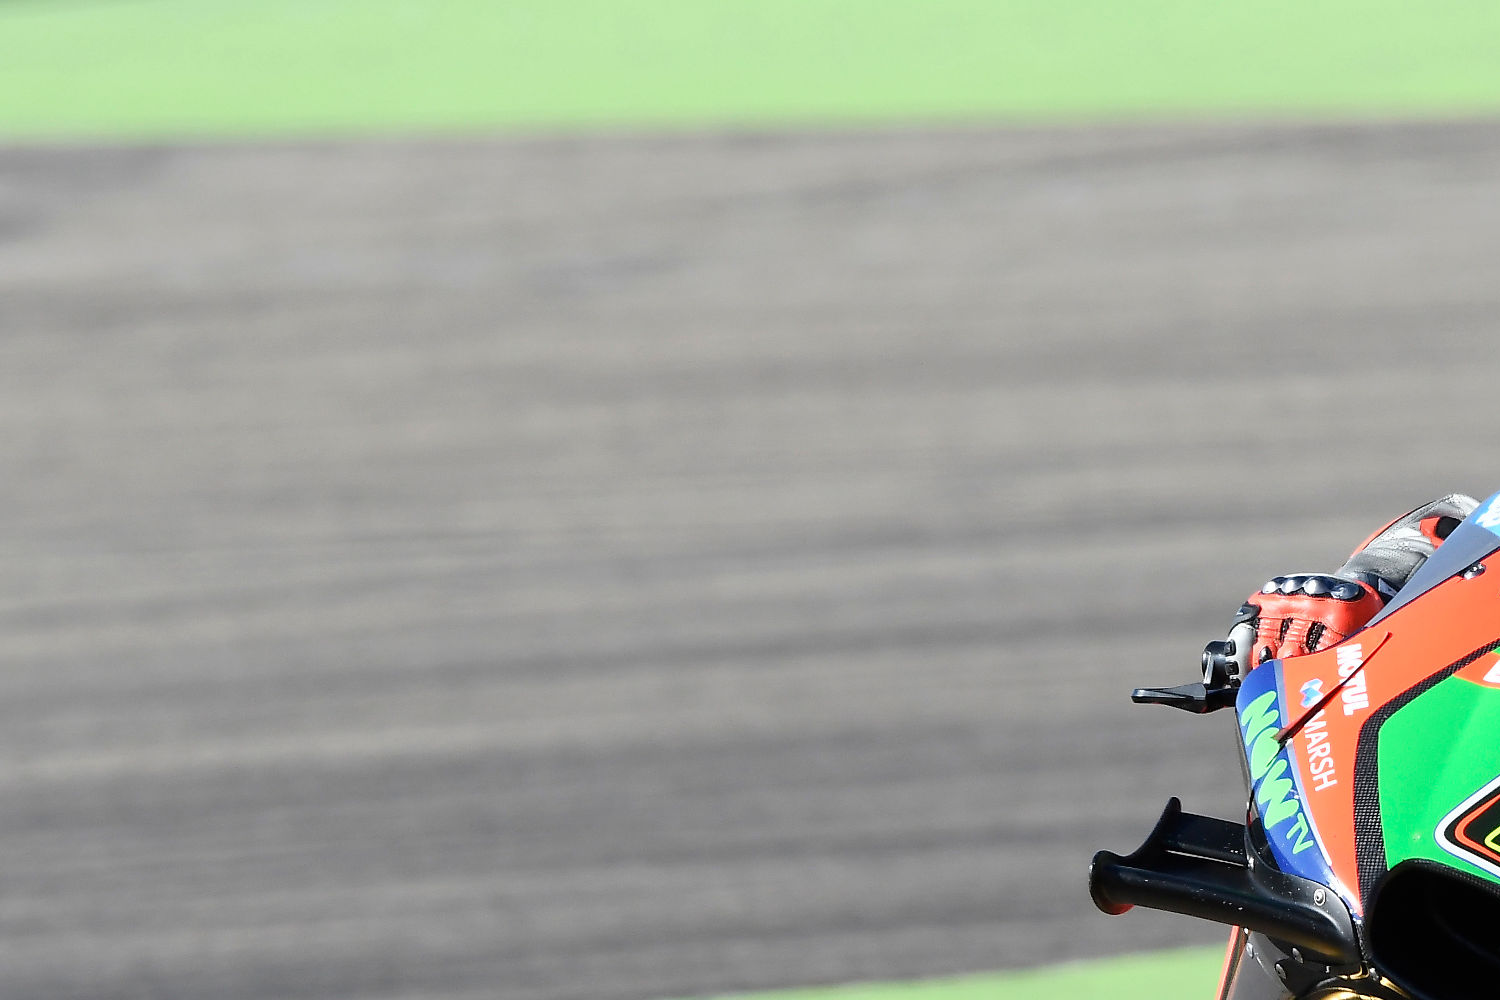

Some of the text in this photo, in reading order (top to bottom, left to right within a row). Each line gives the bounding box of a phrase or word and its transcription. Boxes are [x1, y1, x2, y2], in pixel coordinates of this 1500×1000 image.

[1336, 643, 1370, 716] MOTUL
[1240, 690, 1300, 831] NOW
[1303, 708, 1338, 792] MARSH
